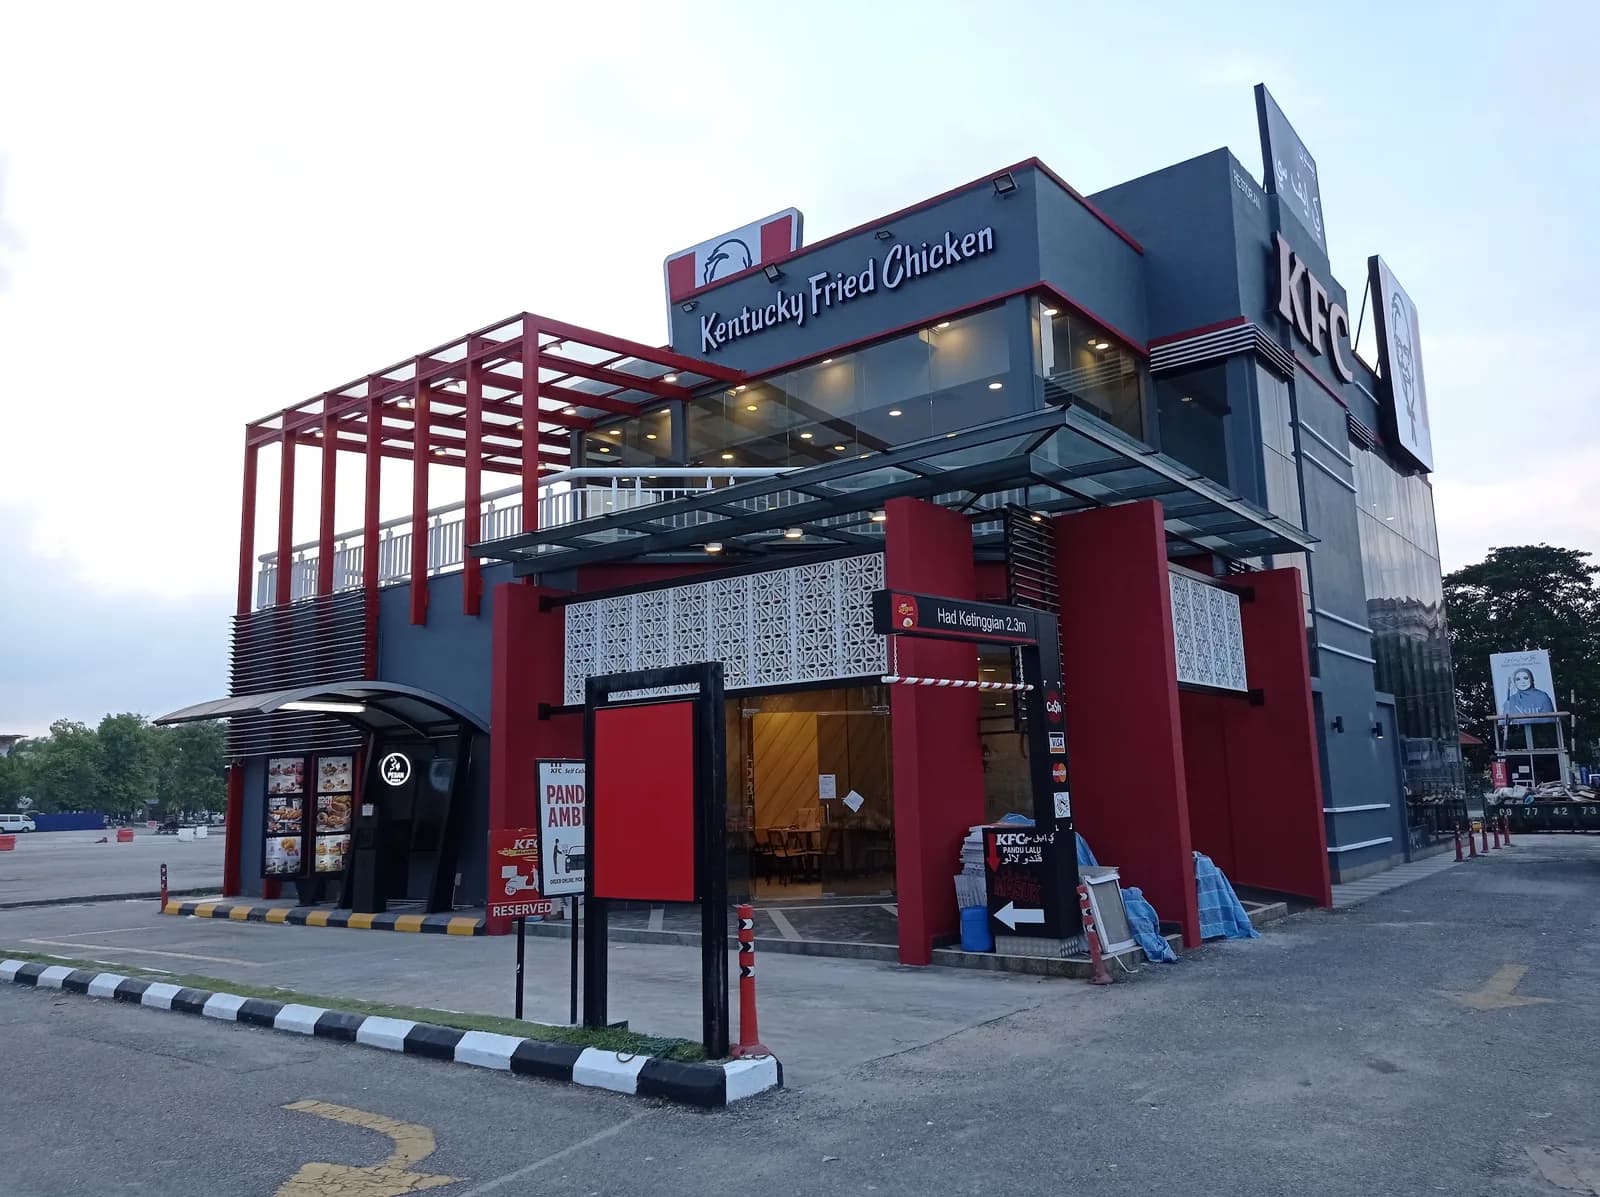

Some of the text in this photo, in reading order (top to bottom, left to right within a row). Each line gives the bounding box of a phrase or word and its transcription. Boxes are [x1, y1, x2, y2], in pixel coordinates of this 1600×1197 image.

[700, 226, 994, 353] Kentucky Fried Chicken
[1273, 231, 1353, 384] KFC
[937, 607, 1027, 633] Had Ketinggian 2.3m
[1051, 738, 1063, 747] VISA
[546, 784, 585, 804] PAND
[548, 807, 585, 827] AMBI
[1525, 807, 1538, 815] 77
[1553, 807, 1568, 815] 42
[1582, 806, 1597, 815] 73
[996, 833, 1025, 846] KFC
[1003, 846, 1042, 854] PANDU LALU
[492, 902, 552, 917] RESERVED
